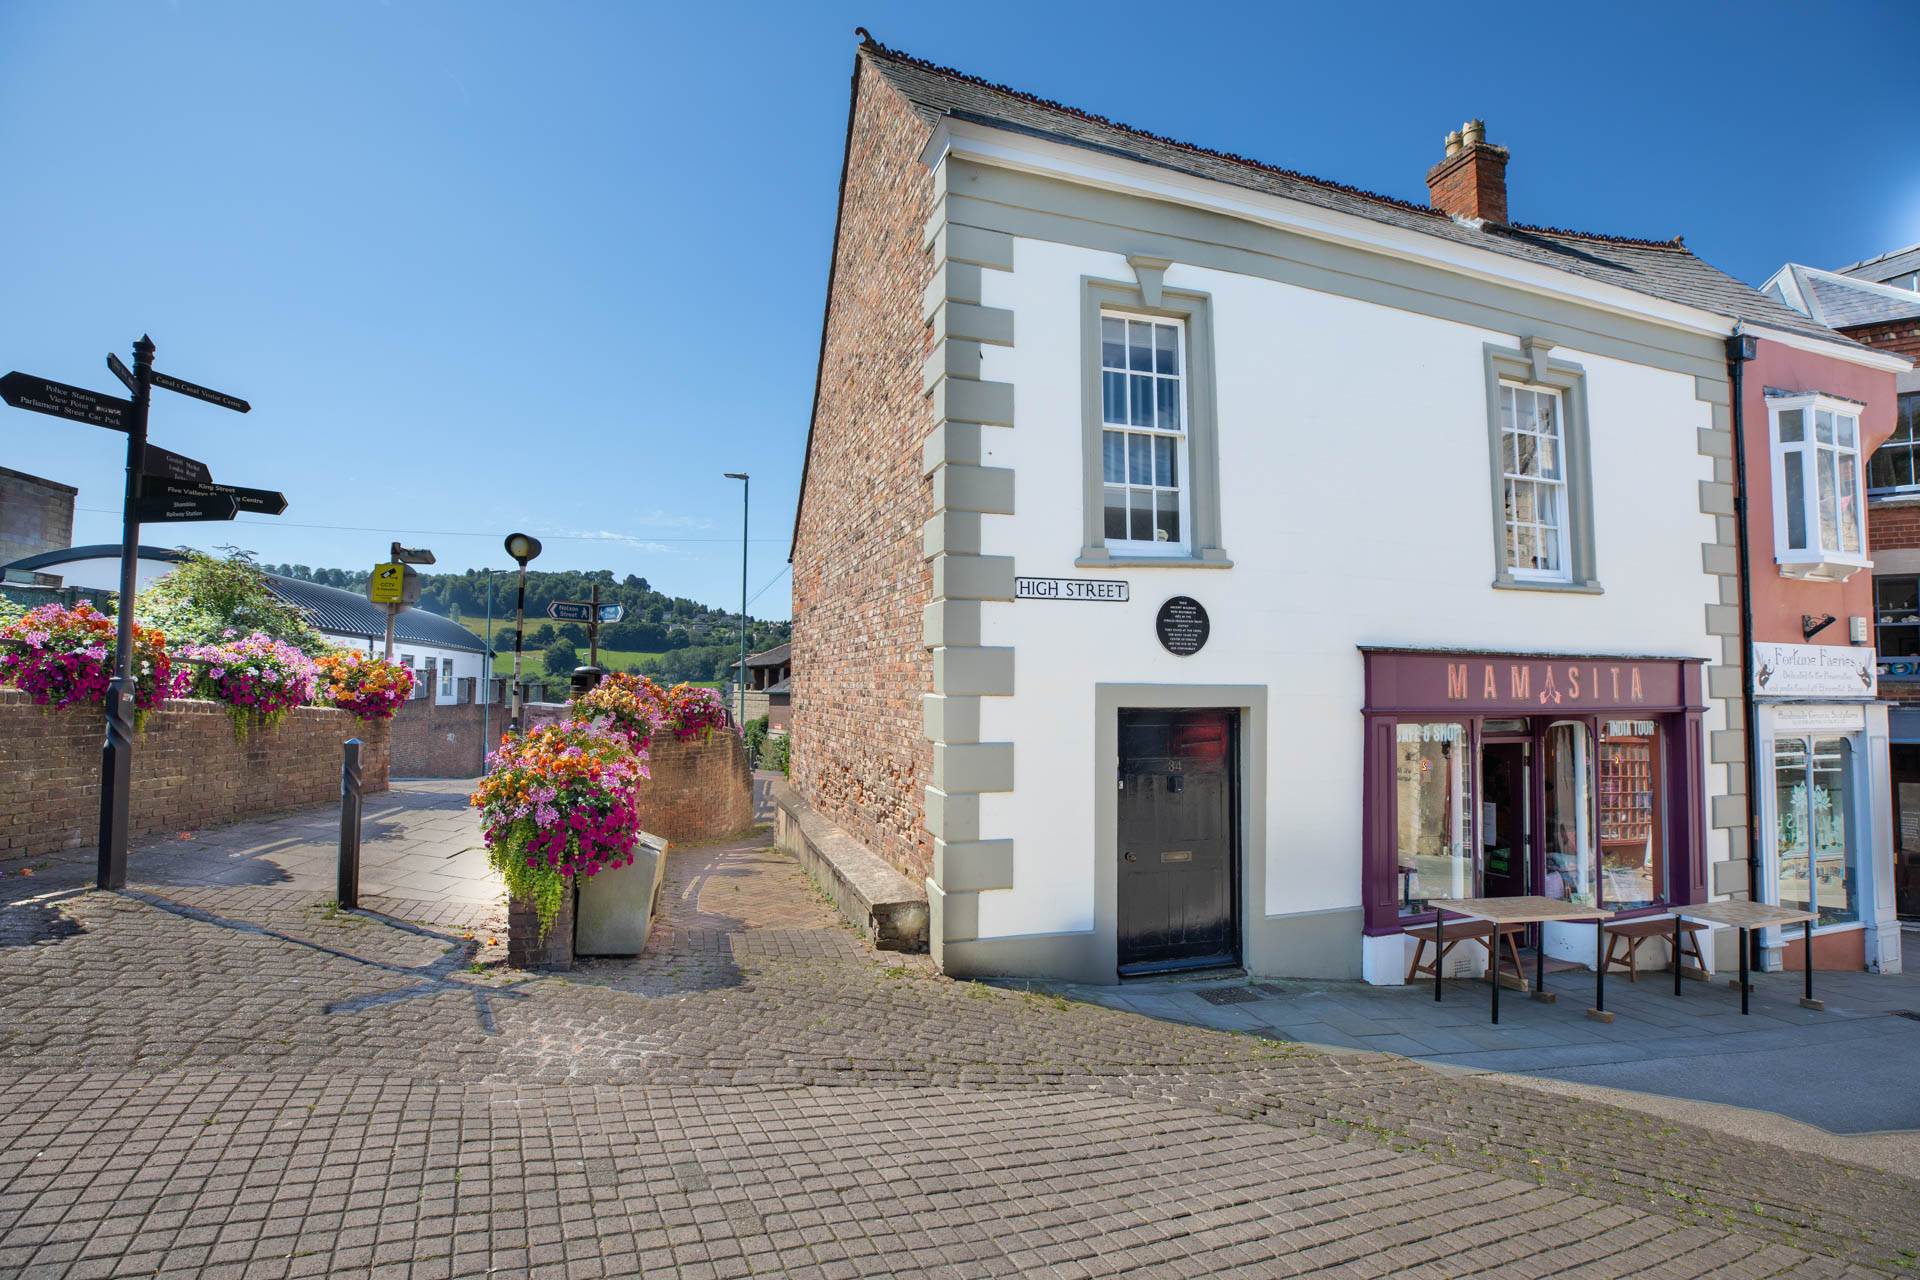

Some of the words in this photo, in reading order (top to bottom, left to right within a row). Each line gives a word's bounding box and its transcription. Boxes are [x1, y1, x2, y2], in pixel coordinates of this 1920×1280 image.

[46, 384, 68, 396] Police
[71, 391, 97, 403] Station
[156, 376, 176, 388] Canal
[181, 384, 200, 395] Canal
[20, 396, 59, 411] Parliament
[64, 406, 86, 418] Street
[88, 412, 103, 422] Car
[104, 417, 121, 426] Park
[49, 393, 68, 405] View
[70, 401, 90, 411] Point
[167, 486, 182, 494] Five
[241, 496, 264, 505] Centre
[198, 483, 215, 492] King
[215, 484, 236, 494] Street
[166, 511, 186, 519] Railway
[185, 510, 203, 518] Station
[1019, 580, 1059, 597] HIGH
[1066, 582, 1125, 598] STREET
[1774, 647, 1817, 665] Fortune
[1448, 663, 1643, 704] MAMASITA
[1168, 759, 1182, 772] 34
